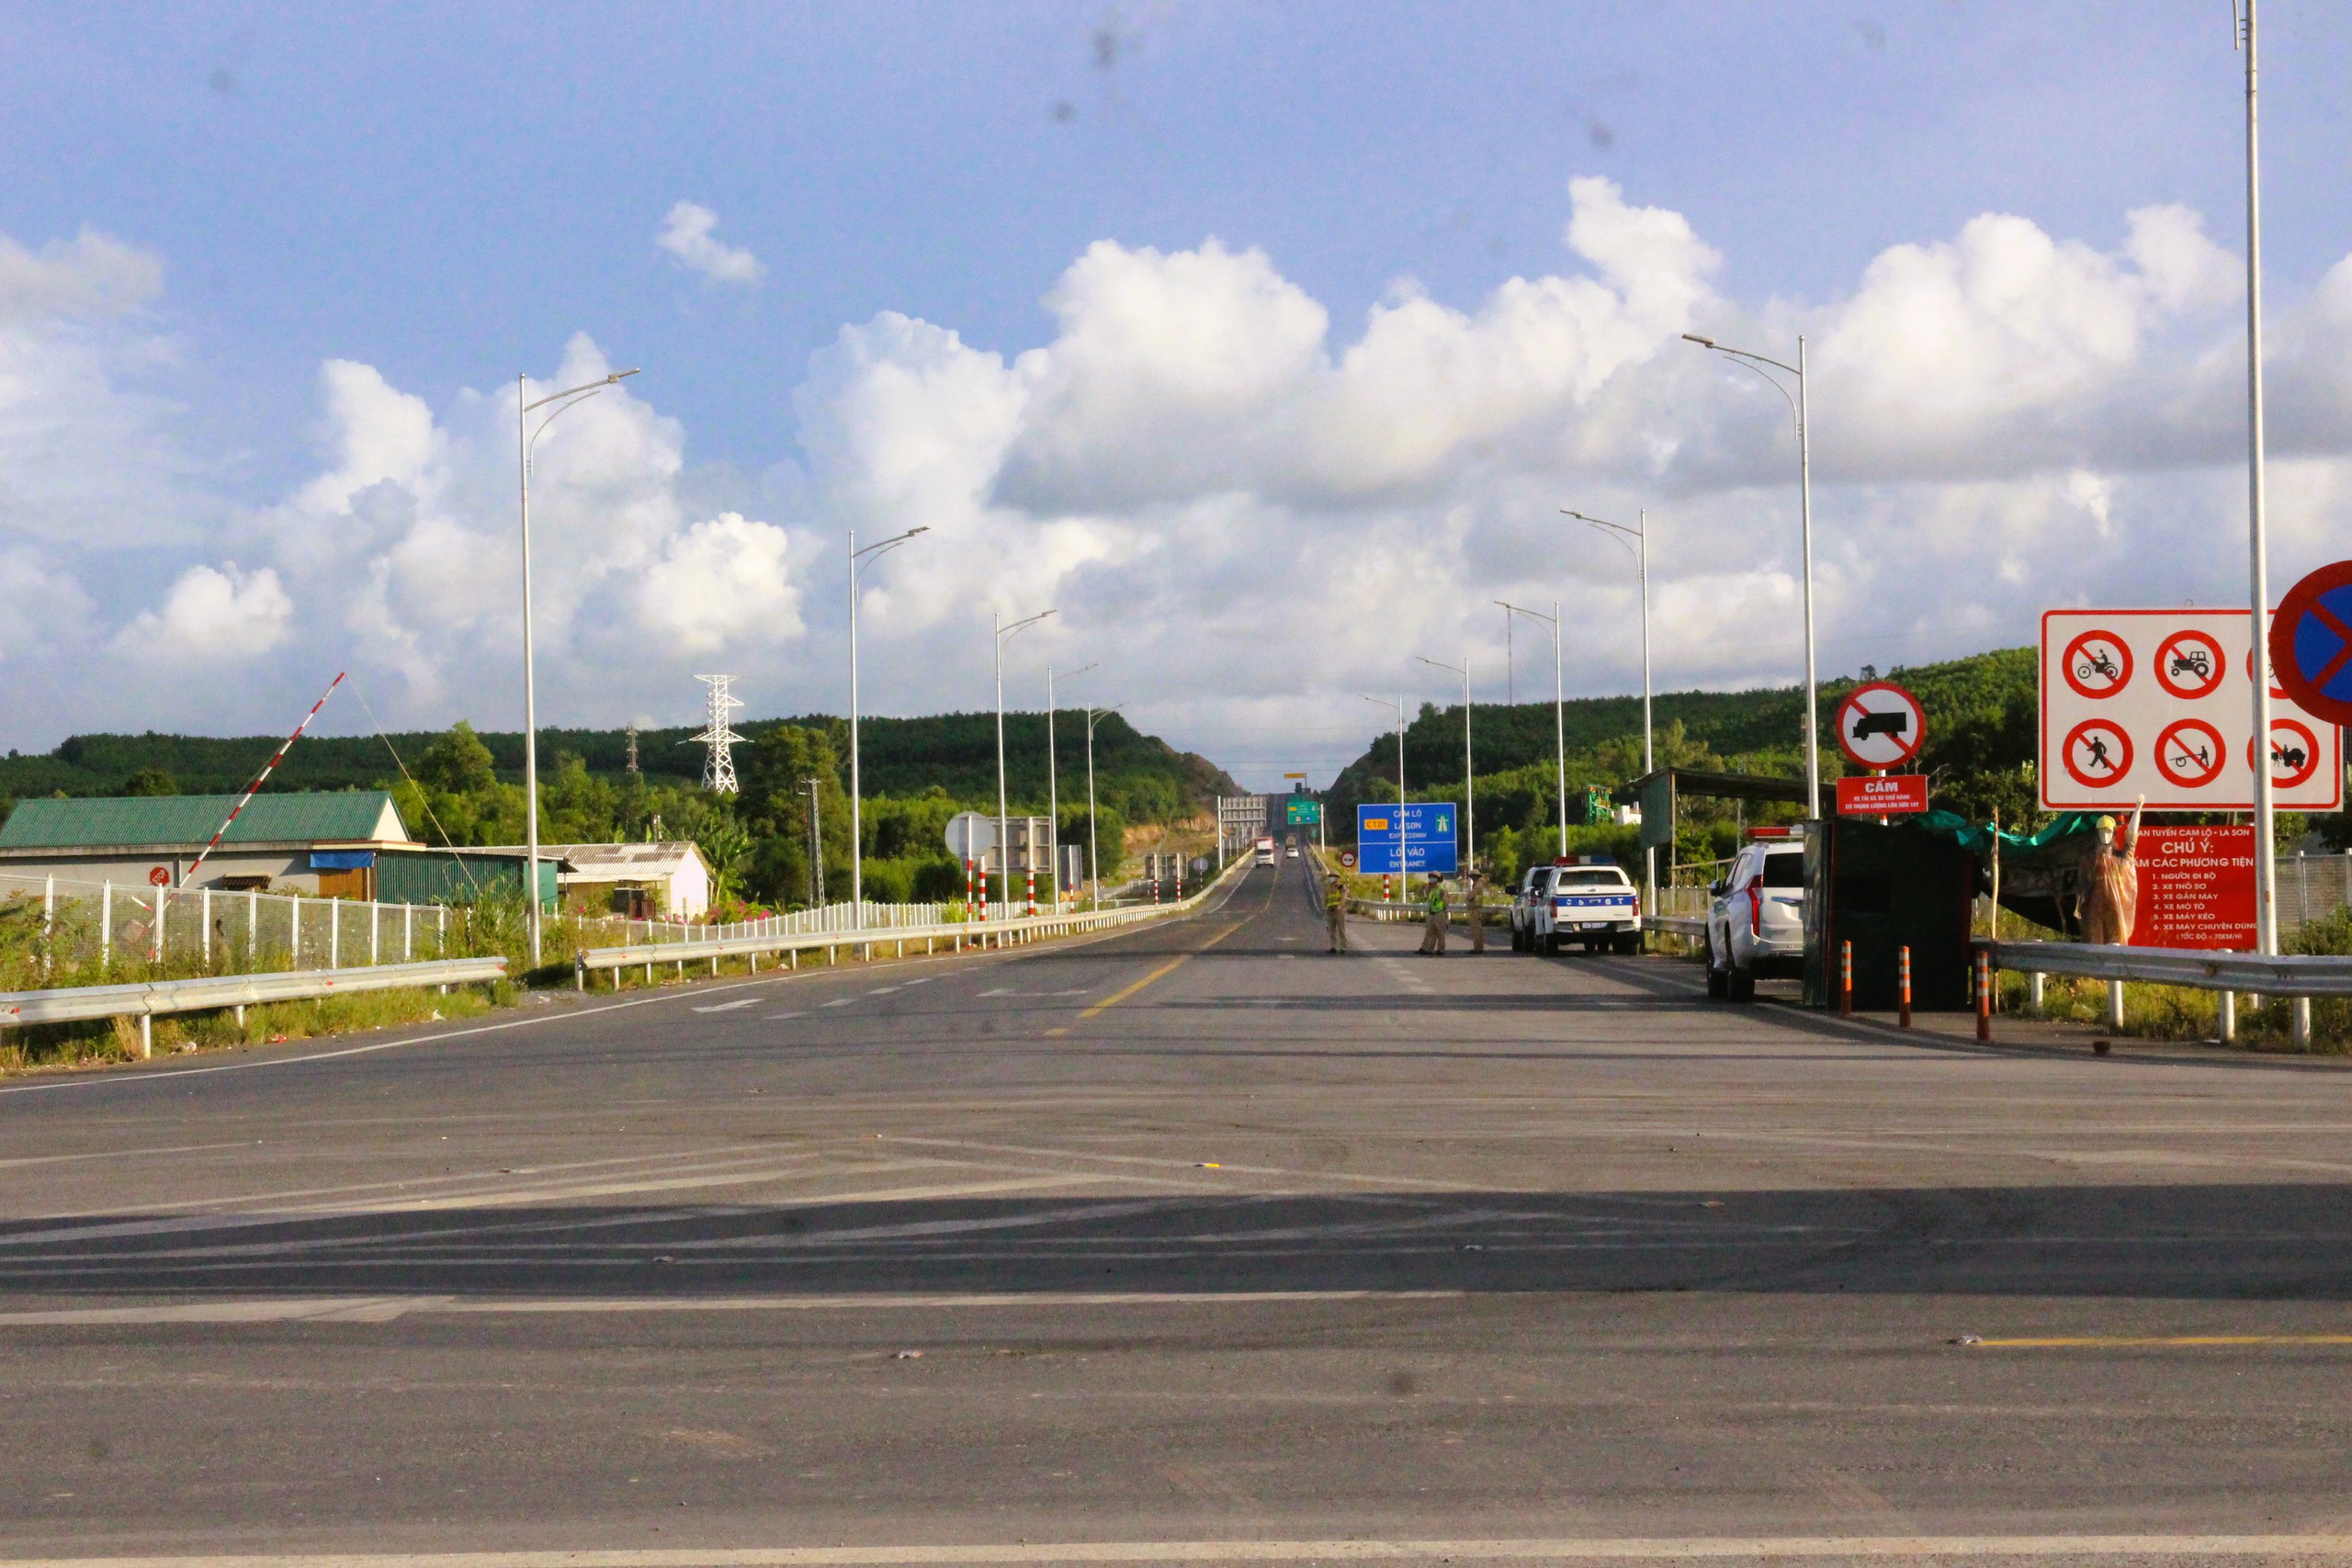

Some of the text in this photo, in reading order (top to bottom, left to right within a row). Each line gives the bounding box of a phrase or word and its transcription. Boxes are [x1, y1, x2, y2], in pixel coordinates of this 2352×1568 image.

[2161, 837, 2214, 853] CHÚ Ý:
[1389, 846, 1425, 857] LỐ VÀO
[2152, 856, 2178, 868] CÁC
[2180, 857, 2229, 867] PHƯƠNG
